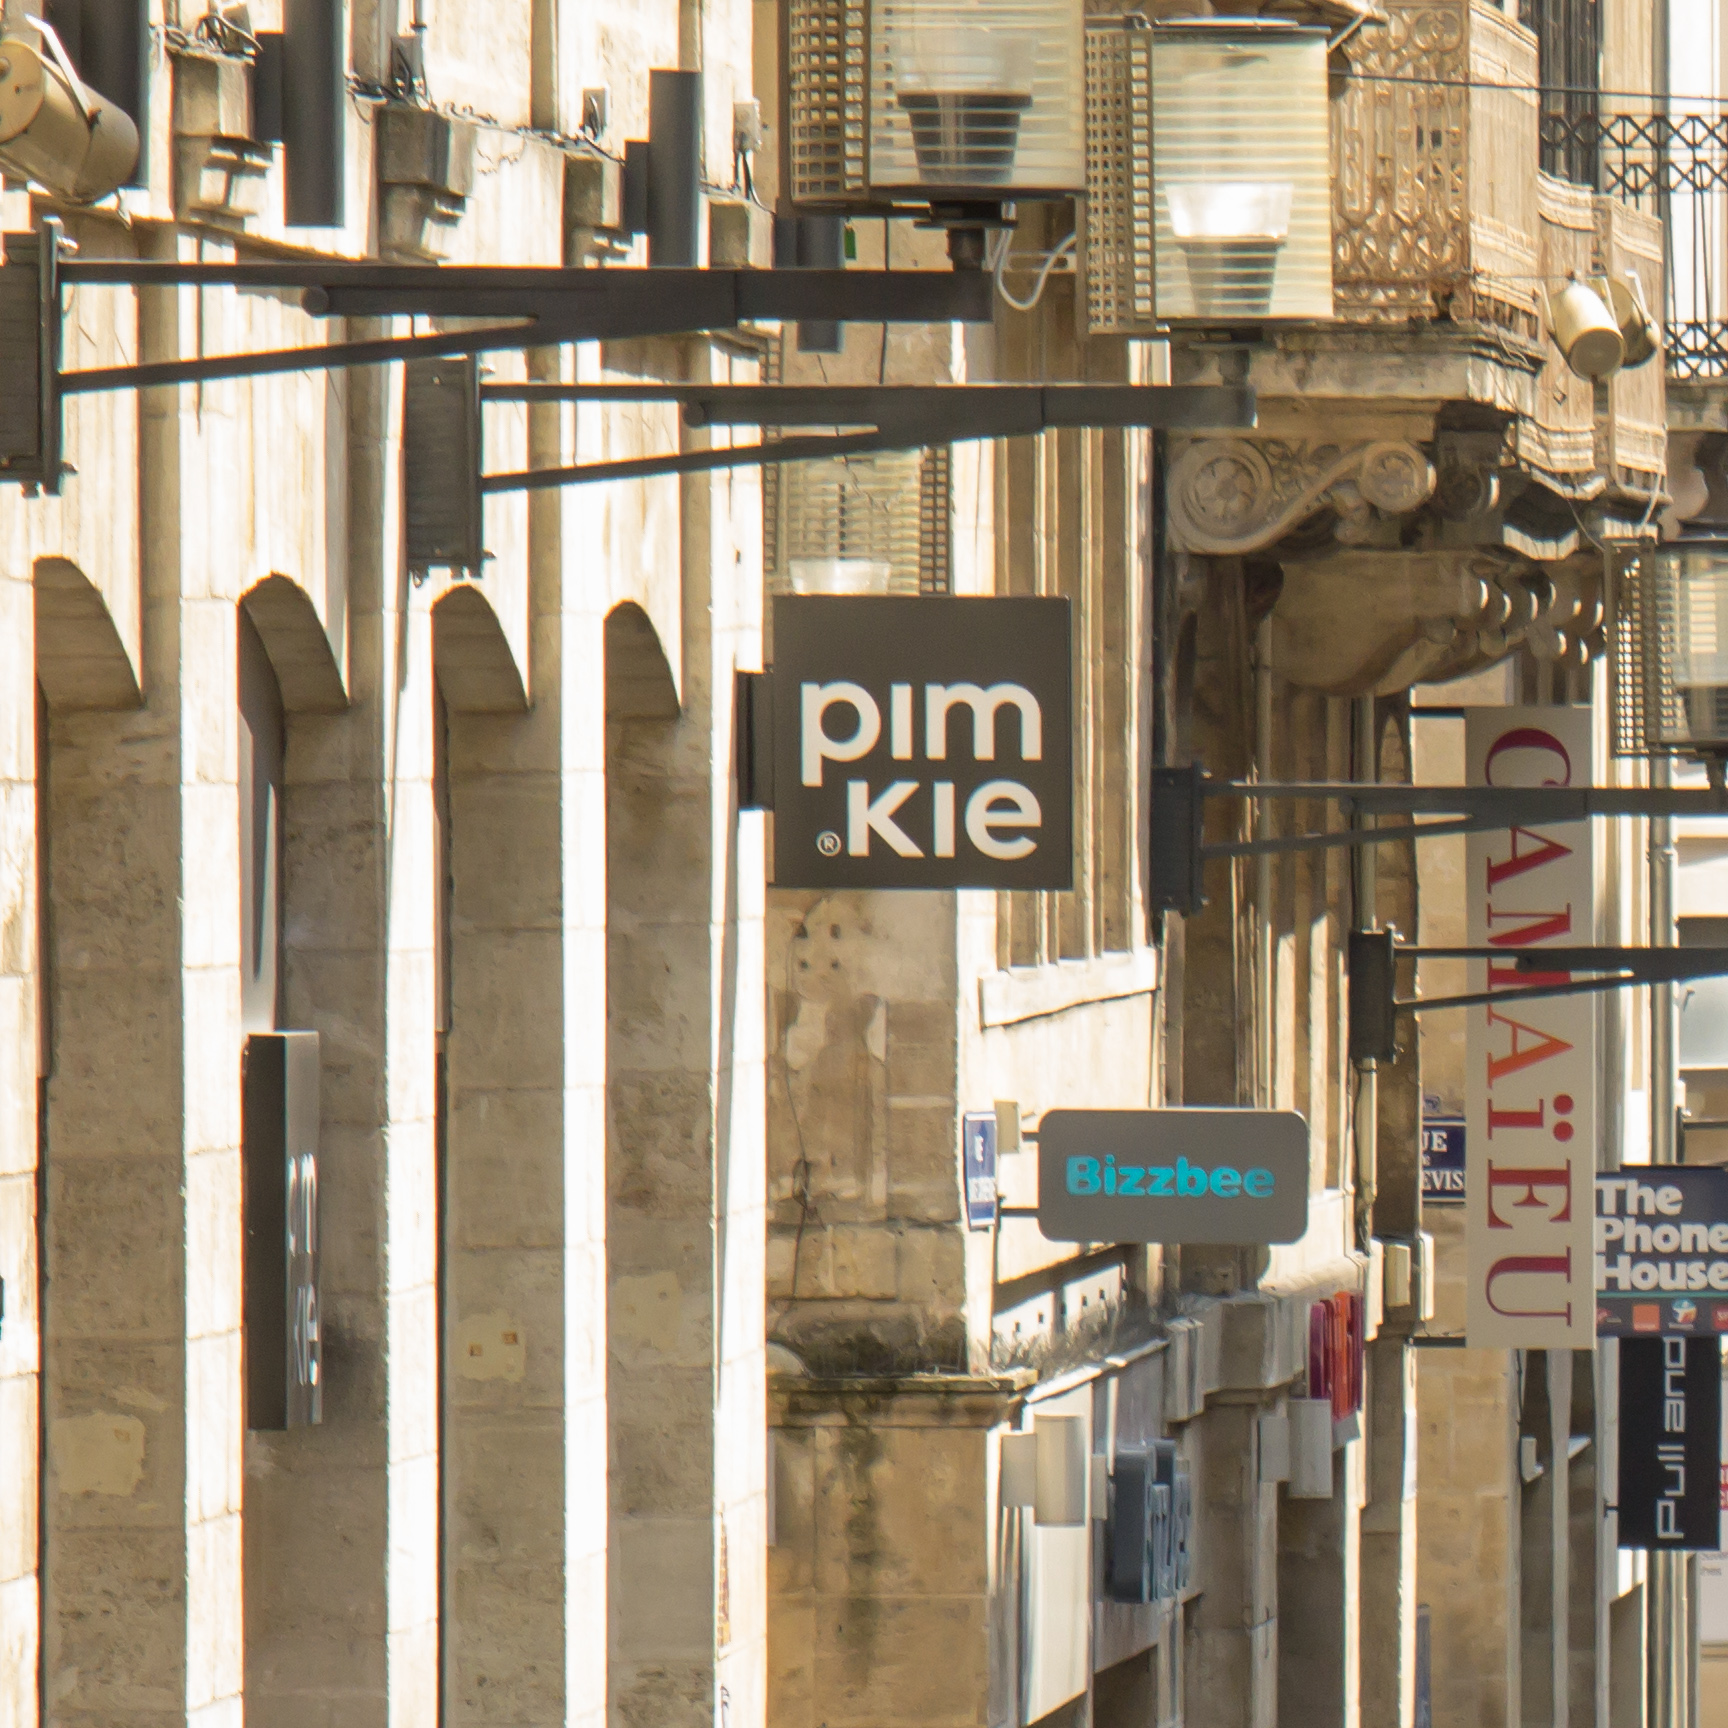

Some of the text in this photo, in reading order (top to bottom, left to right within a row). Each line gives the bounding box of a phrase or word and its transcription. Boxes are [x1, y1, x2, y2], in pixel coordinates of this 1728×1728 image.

[801, 681, 1042, 788] pim
[1066, 1154, 1275, 1198] Bizzbee
[1595, 1178, 1683, 1217] The
[1656, 1443, 1685, 1539] Pull
